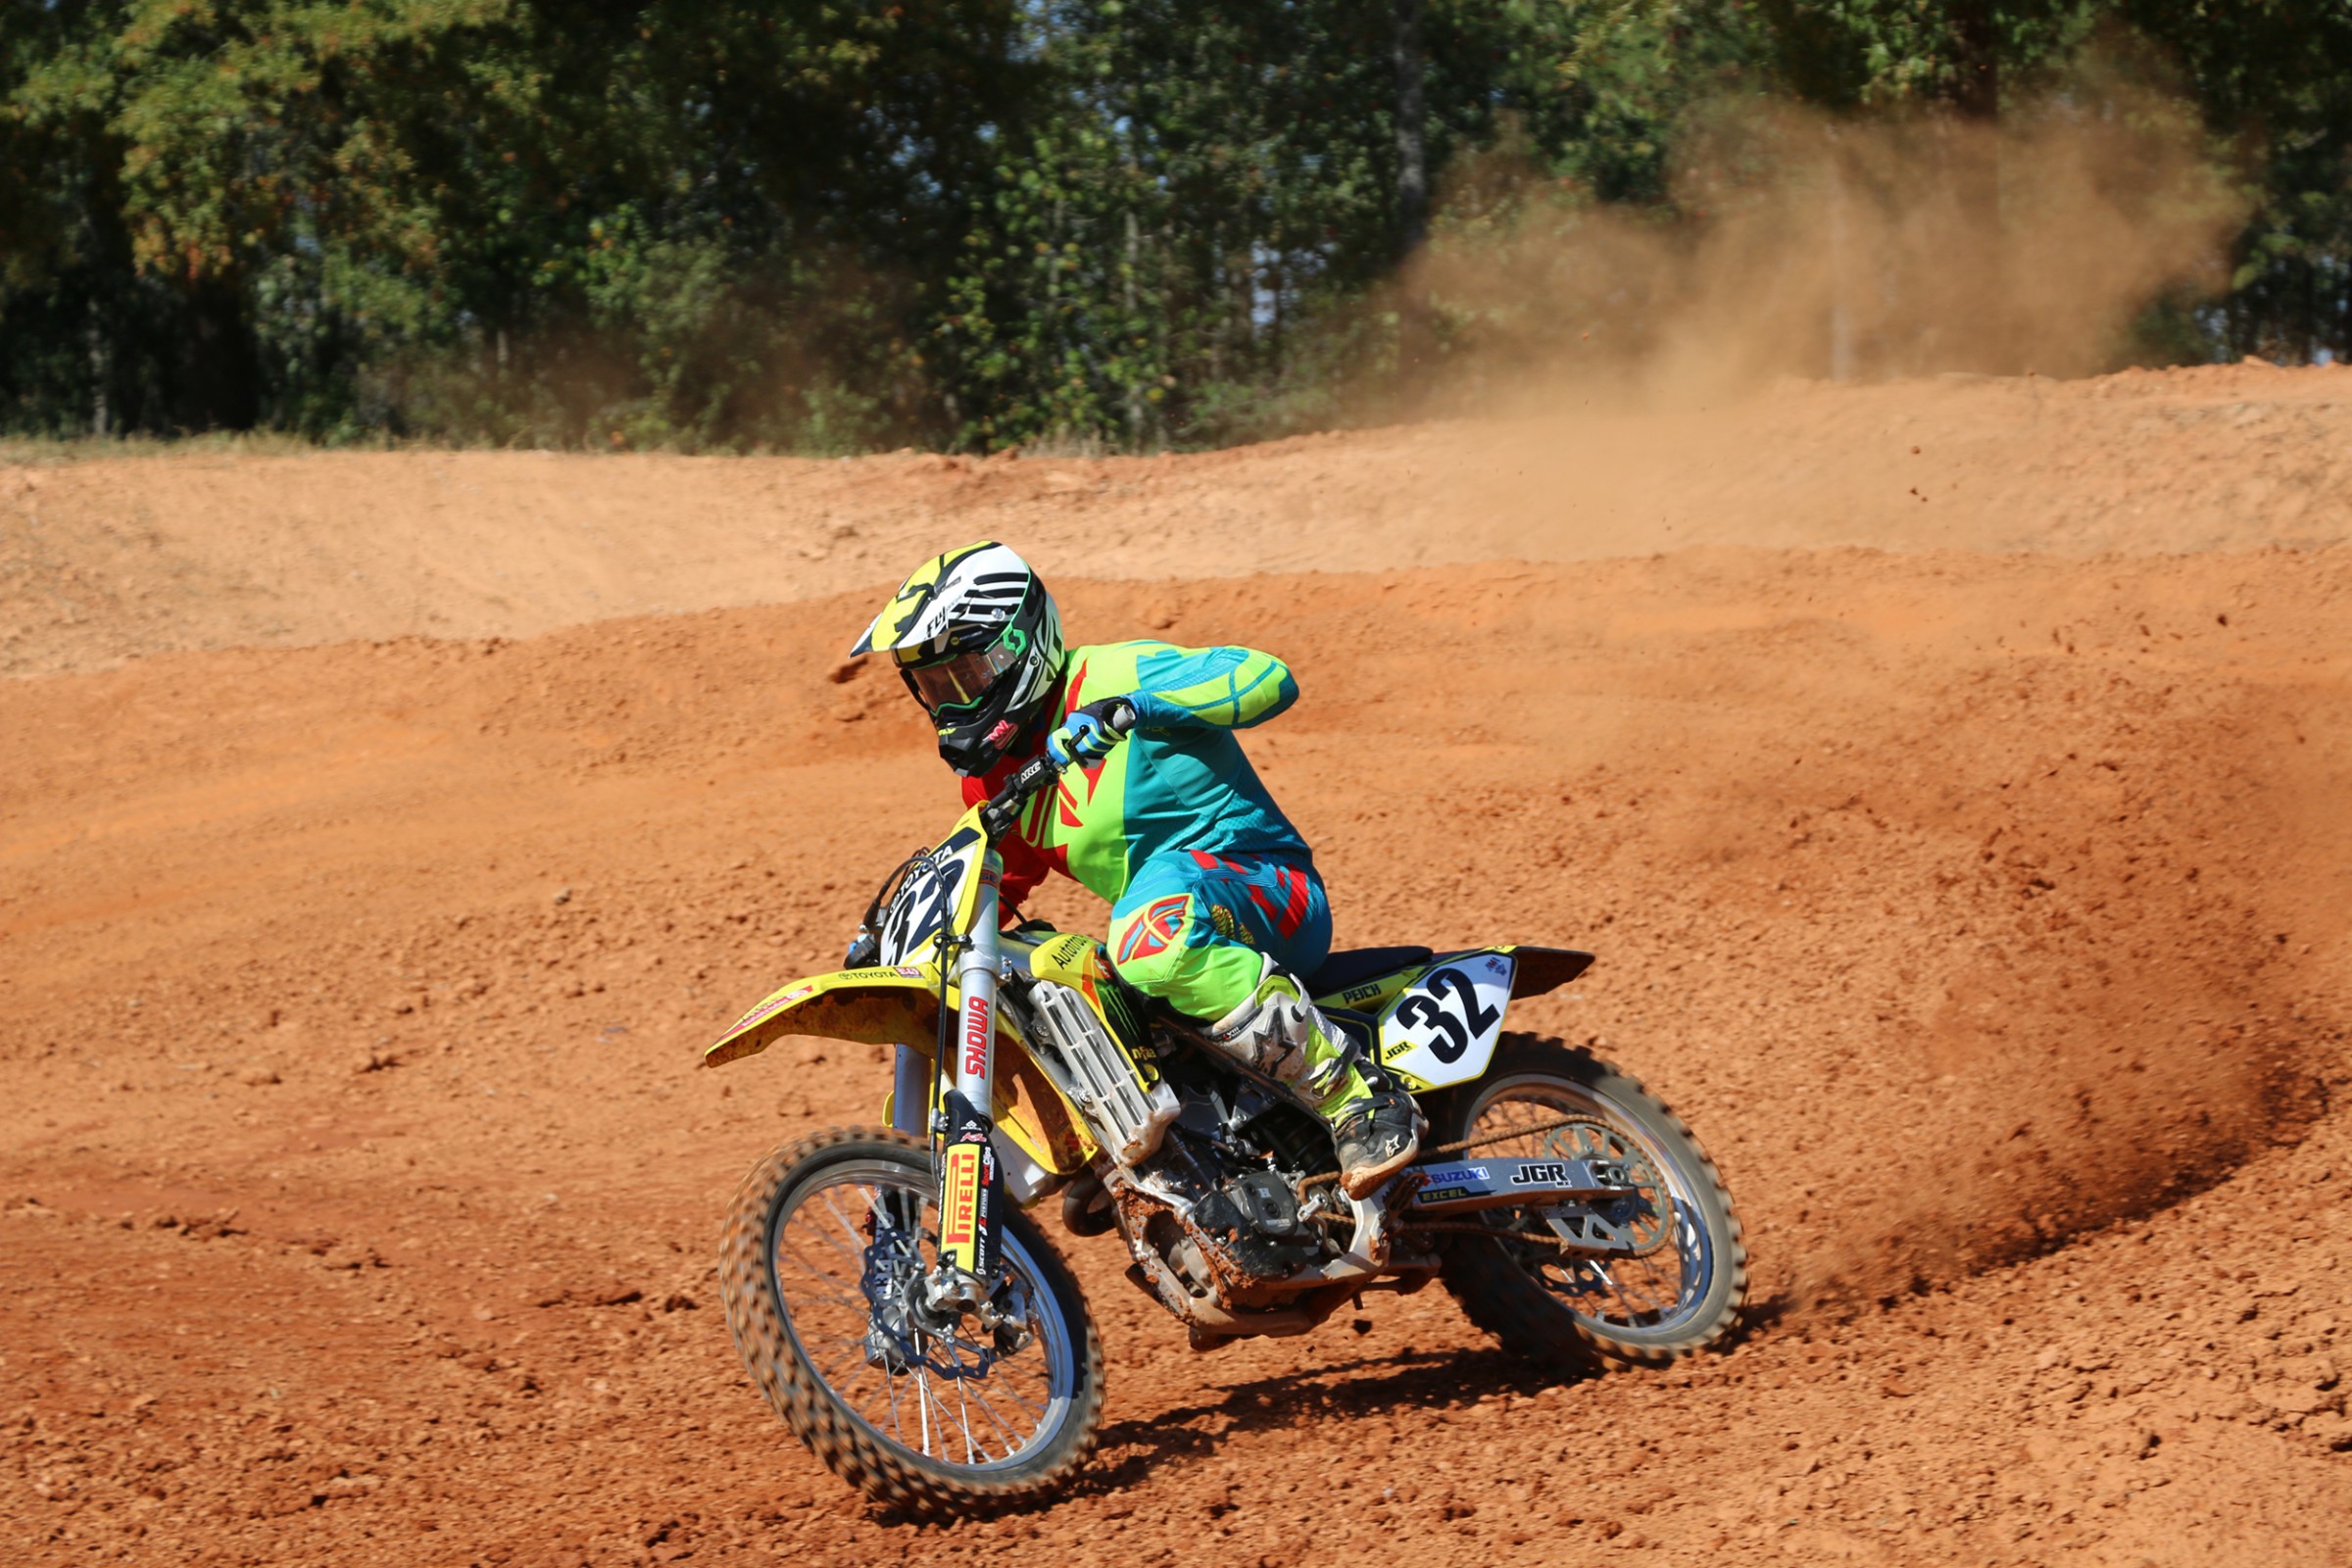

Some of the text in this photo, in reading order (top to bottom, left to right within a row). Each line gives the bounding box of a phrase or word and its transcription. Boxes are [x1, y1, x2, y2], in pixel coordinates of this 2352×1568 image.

[1020, 760, 1042, 784] ARC
[853, 970, 899, 979] TOYOTA
[1396, 967, 1500, 1064] 32
[965, 996, 989, 1080] SHOWA
[1385, 1041, 1411, 1060] JGR
[1432, 1167, 1490, 1185] SUZUKI
[1512, 1163, 1567, 1185] JGR
[946, 1153, 975, 1244] PIRELLI
[1423, 1189, 1467, 1201] EXCEL
[978, 1238, 987, 1268] SCOTT
